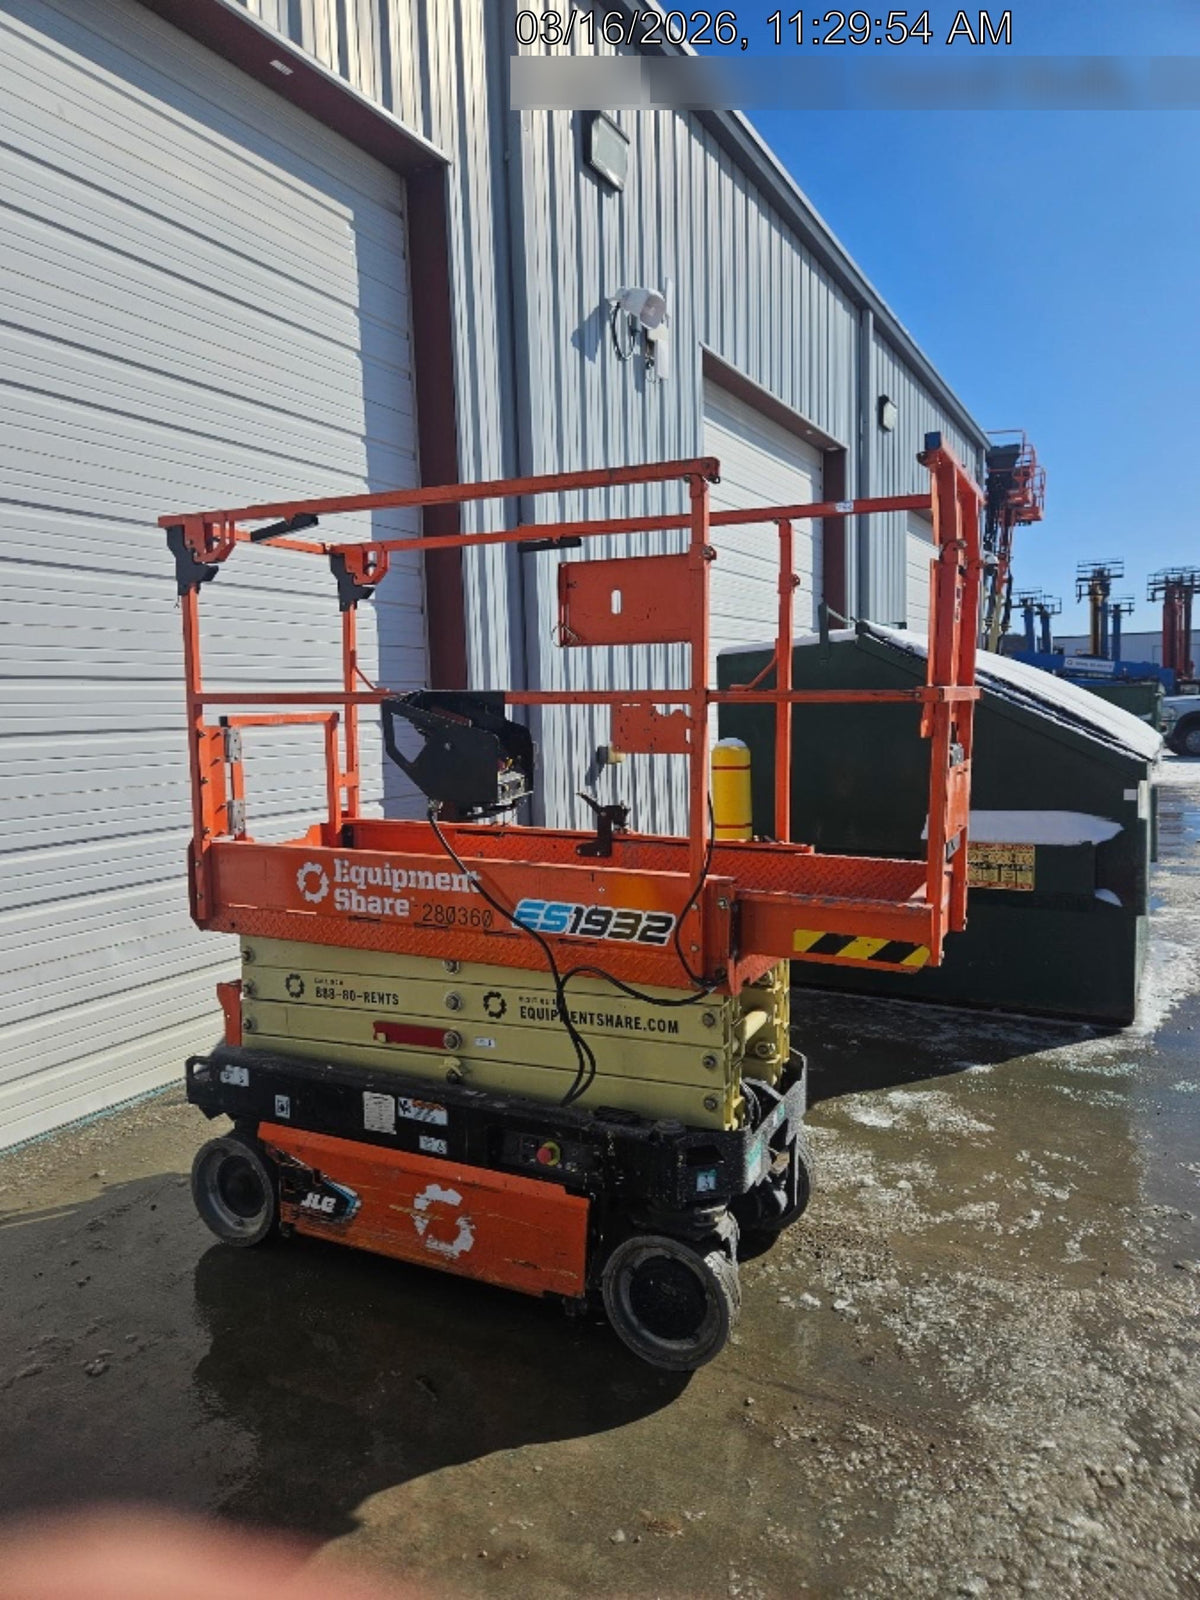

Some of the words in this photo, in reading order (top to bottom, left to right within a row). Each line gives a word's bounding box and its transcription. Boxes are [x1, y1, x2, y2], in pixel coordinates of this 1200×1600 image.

[333, 858, 482, 893] Equipment
[333, 887, 410, 916] Share
[422, 902, 494, 928] 280360
[512, 899, 676, 946] ES1932
[519, 1005, 679, 1033] EQUIPENTSHARE.COM
